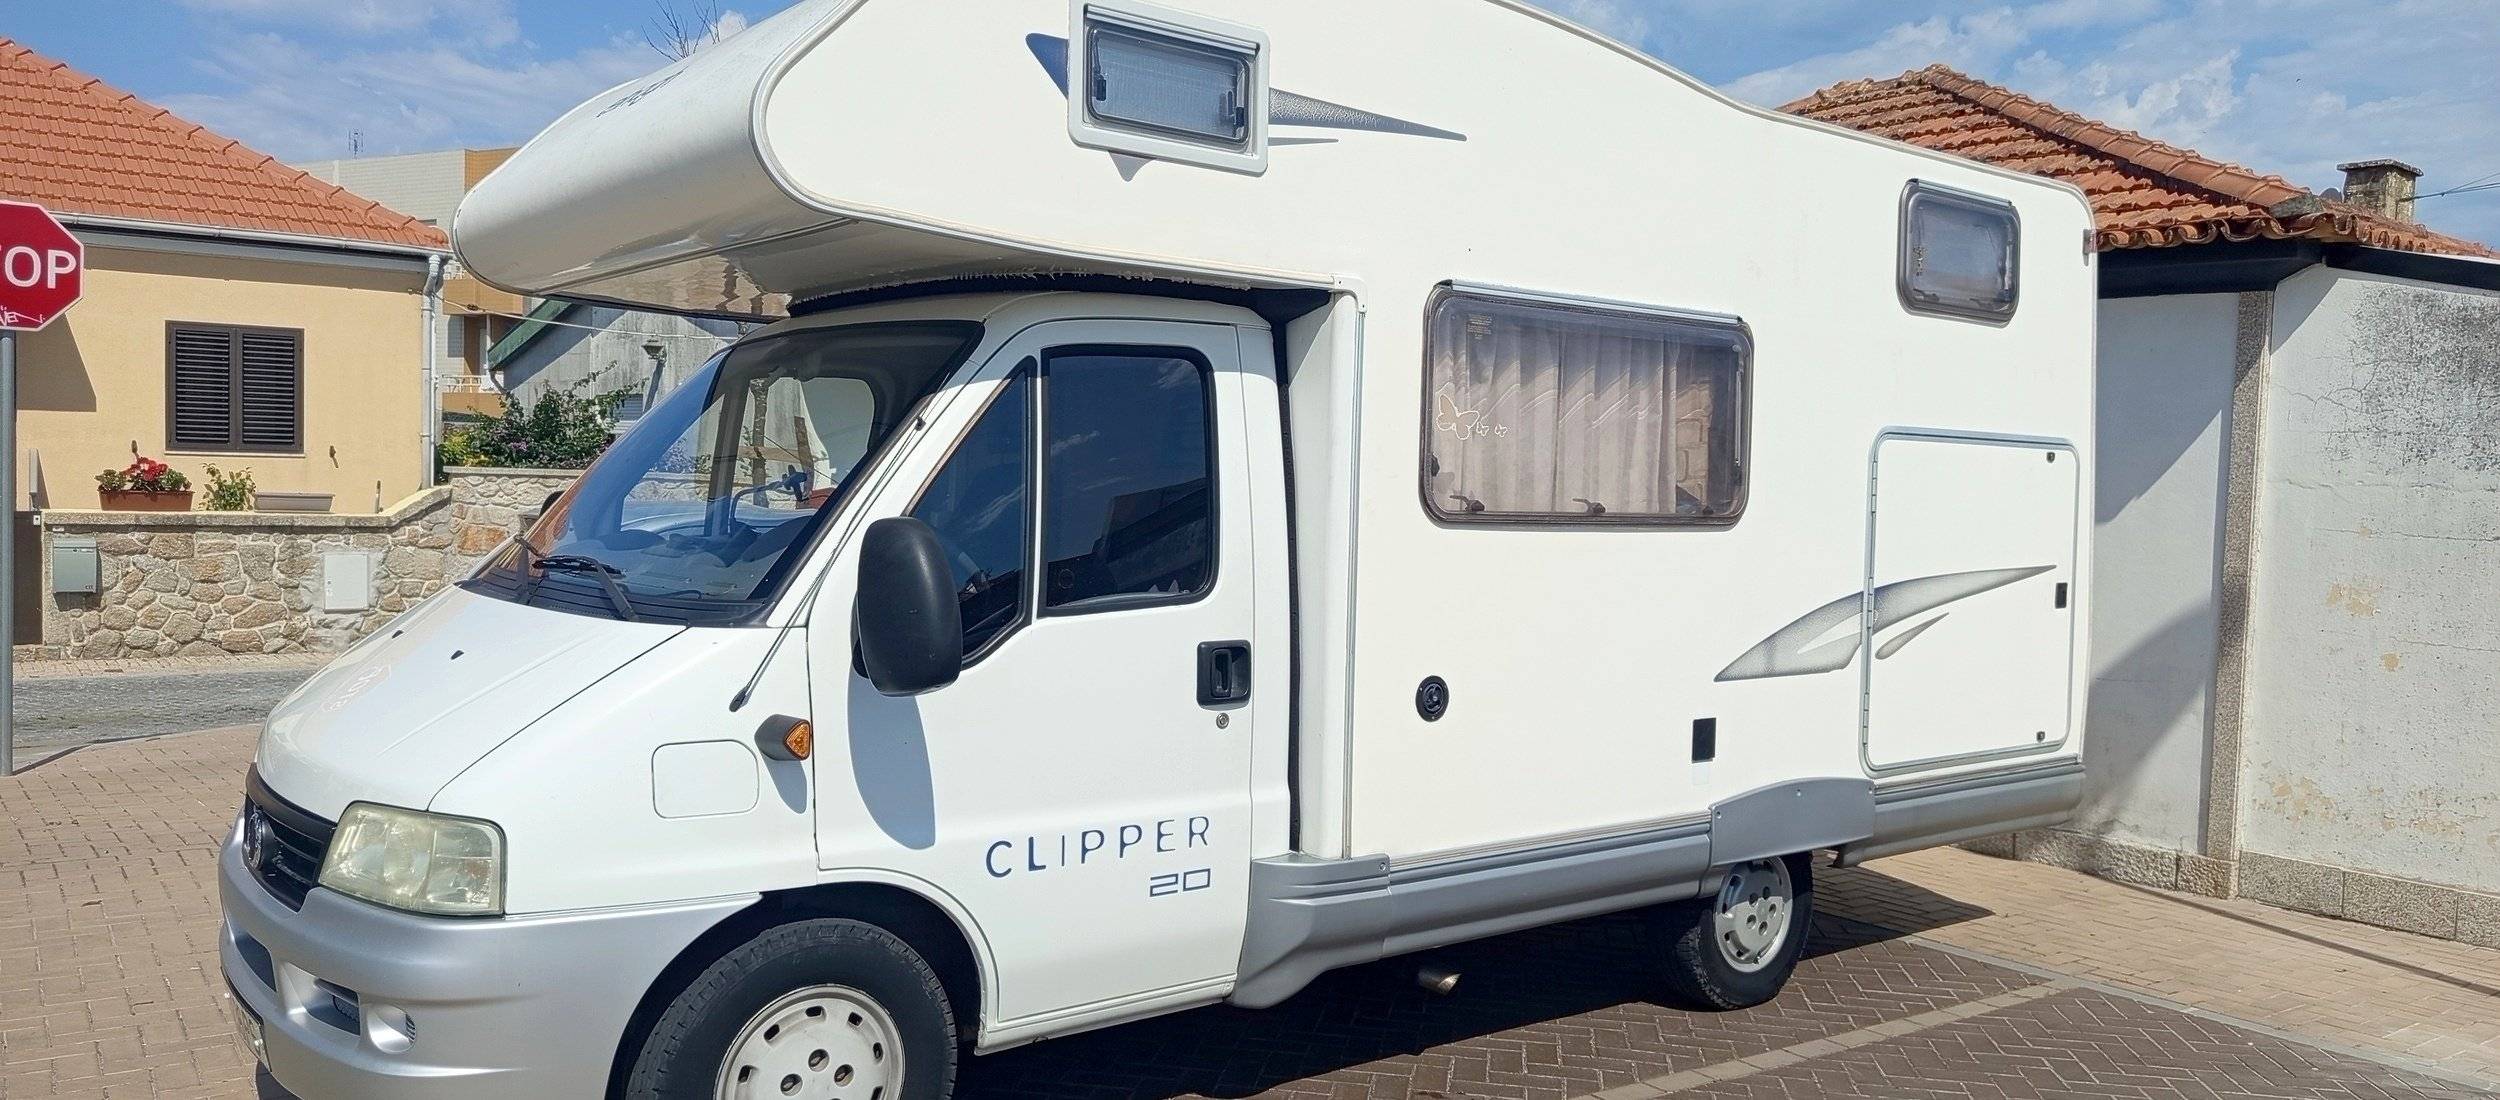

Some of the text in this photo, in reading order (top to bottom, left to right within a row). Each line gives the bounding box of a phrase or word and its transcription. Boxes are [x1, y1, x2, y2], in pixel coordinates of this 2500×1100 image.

[0, 245, 77, 289] OP
[986, 816, 1210, 877] CLIPPER
[1150, 868, 1211, 897] 20
